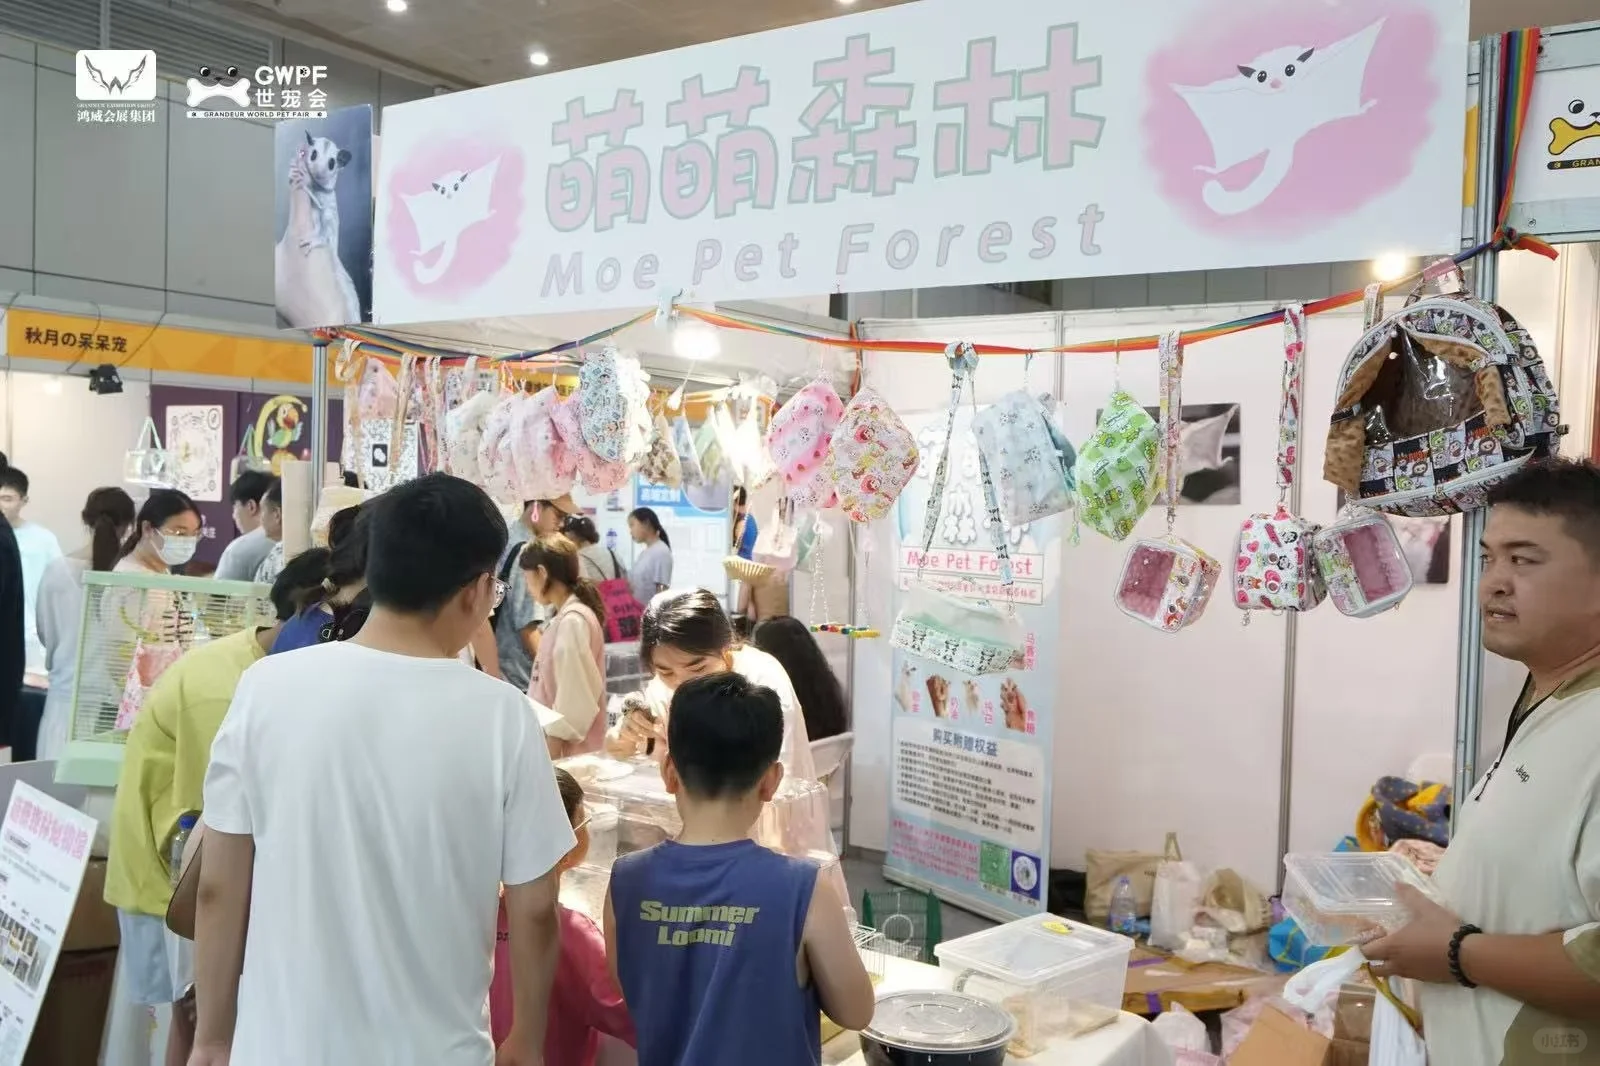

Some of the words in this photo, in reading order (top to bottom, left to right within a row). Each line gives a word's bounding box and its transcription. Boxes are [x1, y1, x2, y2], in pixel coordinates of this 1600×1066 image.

[545, 22, 1106, 233] 萌萌森林
[539, 250, 660, 298] Moe
[692, 233, 800, 285] Pet
[836, 203, 1105, 275] Forest
[25, 327, 127, 353] 秋月の呆呆宠
[946, 553, 971, 570] Pet
[979, 555, 1033, 575] Fost
[640, 900, 760, 924] Summer
[657, 924, 736, 946] Loomi
